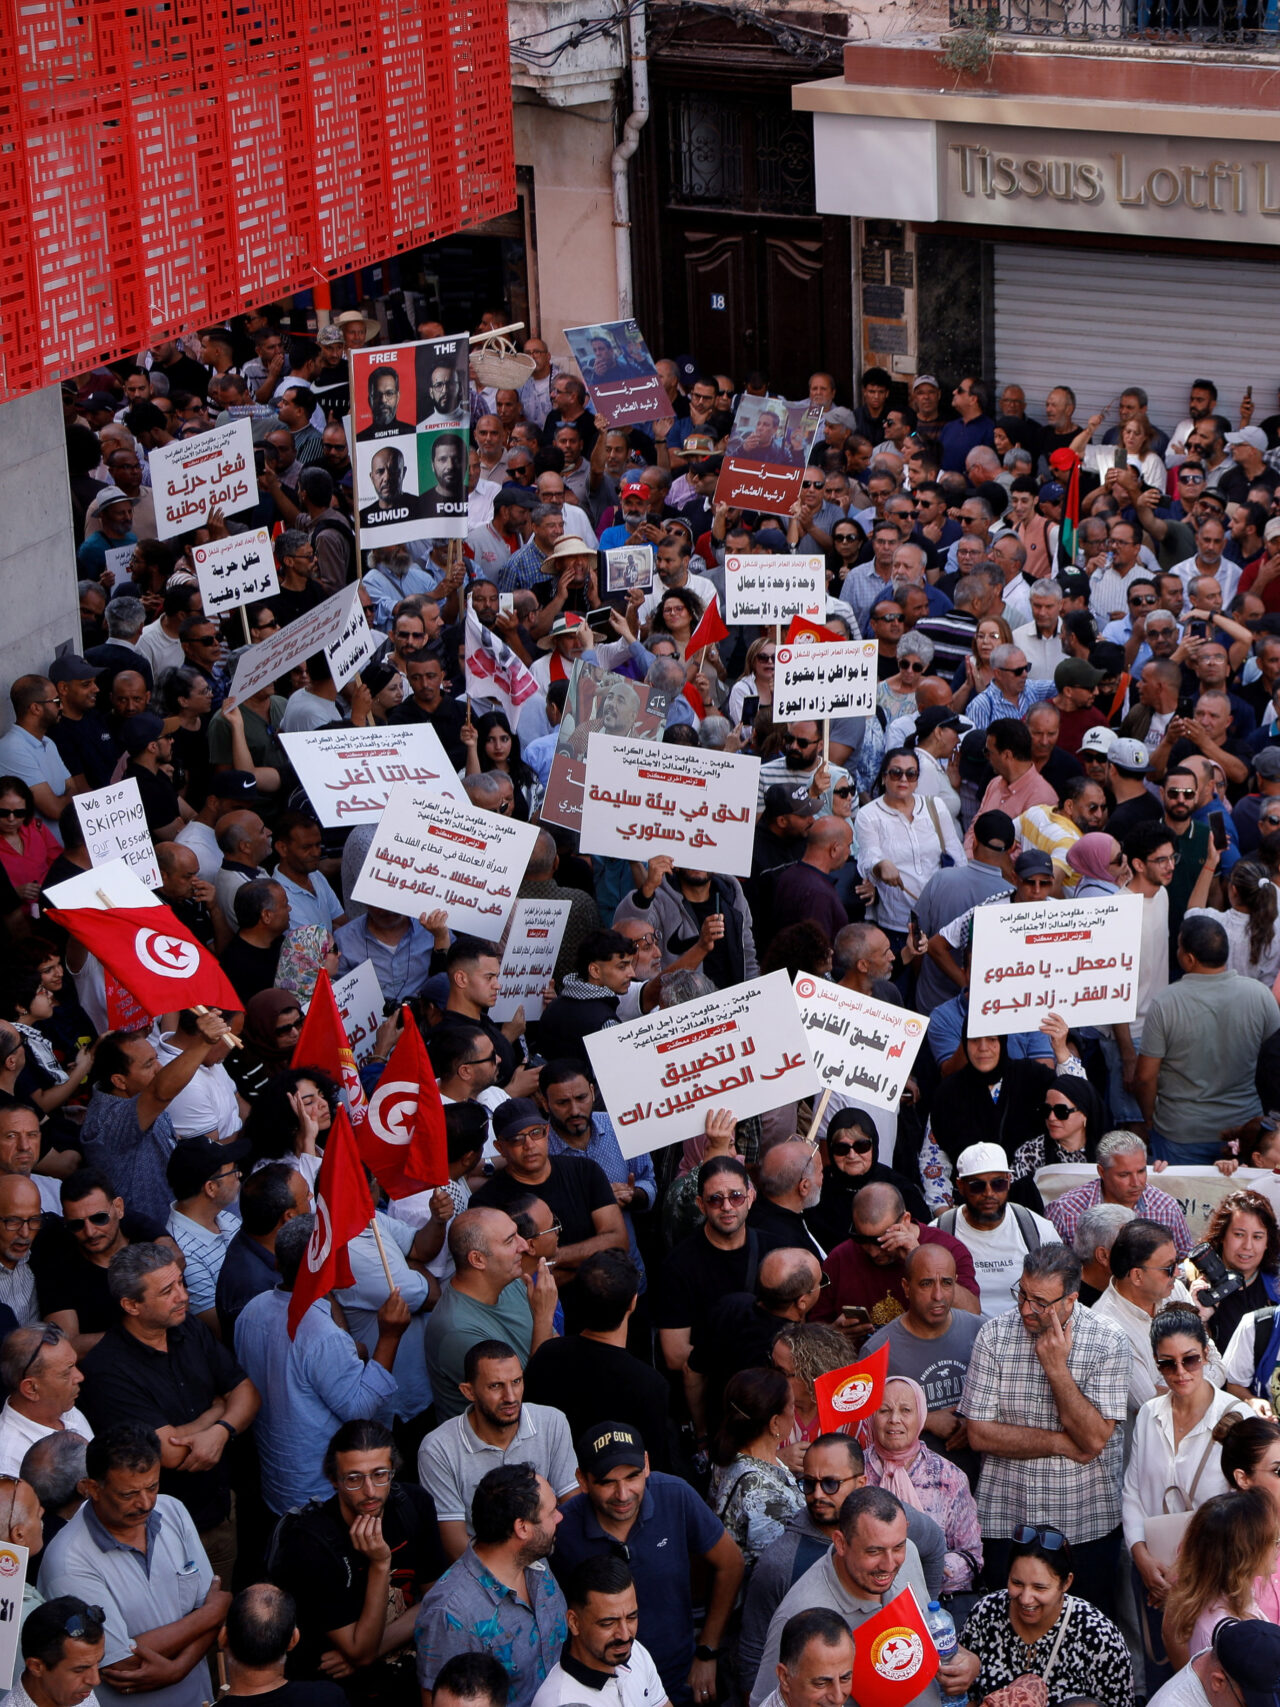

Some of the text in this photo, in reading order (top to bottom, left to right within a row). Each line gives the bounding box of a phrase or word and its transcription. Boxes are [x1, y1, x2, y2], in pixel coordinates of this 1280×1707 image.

[948, 143, 1102, 202] Tissus
[1110, 151, 1244, 213] Lotfi
[712, 295, 725, 309] 18
[369, 342, 456, 364] FREE THE
[211, 453, 245, 484] شغل
[166, 480, 248, 523] كرامة وطنية
[367, 508, 409, 524] SUMUD
[212, 562, 238, 577] حرية
[208, 574, 271, 606] كرامة وطنية
[737, 575, 815, 592] وحدة وحدة يا عمال
[781, 604, 803, 618] القمع
[806, 603, 819, 615] ضد
[784, 663, 868, 685] يا مواطن يا مقموع
[778, 693, 872, 715] زاد الفقر زاد الجوع
[324, 760, 440, 790] حياتنا أغلى
[106, 791, 124, 805] are
[589, 785, 641, 808] سليمة
[646, 792, 676, 816] بيئة
[680, 801, 708, 822] في
[712, 804, 749, 823] الحق
[616, 823, 717, 848] حق دستوري
[121, 849, 153, 866] TEACH
[375, 847, 415, 870] تهميشا
[394, 832, 508, 874] المرأة العاملة في قطاع الفلاحة
[414, 863, 440, 876] كفى
[399, 879, 436, 896] اعترفو
[486, 885, 512, 898] كفى
[477, 903, 503, 916] كفى
[1000, 913, 1029, 923] الكرامة
[1032, 910, 1046, 920] أجل
[1061, 910, 1084, 918] مقاومة
[1095, 906, 1118, 914] مقاومة
[1010, 922, 1046, 933] الاجتماعية
[1049, 920, 1076, 929] والعدالة
[984, 953, 1132, 983] يا معطل يا مقموع
[817, 989, 839, 1002] للشغل
[981, 983, 1131, 1015] زاد الفقر زاد الجوع
[838, 1000, 863, 1011] التونسي
[862, 1007, 882, 1018] العام
[617, 989, 761, 1043] مقاومة مقاومة من أجل الكرامة
[680, 1015, 715, 1034] والعدالة
[633, 1027, 679, 1049] الاجتماعية
[710, 1025, 727, 1037] تونس
[849, 1027, 890, 1052] تطبق
[886, 1040, 906, 1060] لم
[660, 1036, 755, 1088] لا لتضييق
[760, 1053, 806, 1080] على
[822, 1059, 844, 1084] في
[886, 1084, 898, 1102] و
[974, 1260, 1013, 1269] SSENTIALS
[593, 1431, 634, 1452] TOP GUN
